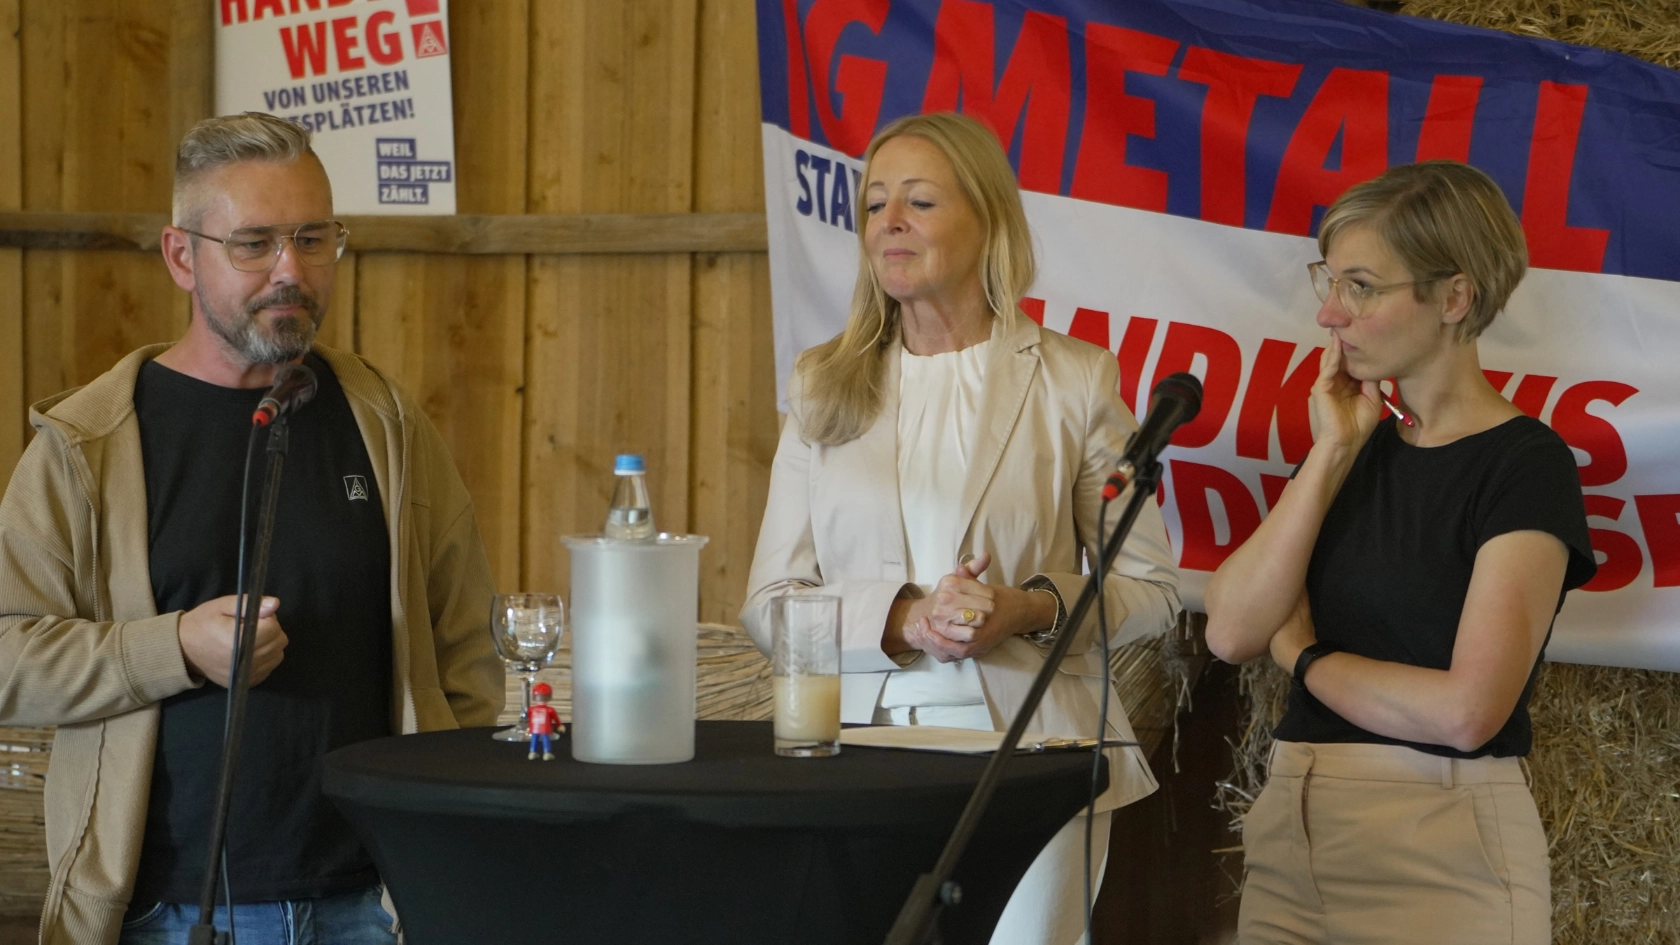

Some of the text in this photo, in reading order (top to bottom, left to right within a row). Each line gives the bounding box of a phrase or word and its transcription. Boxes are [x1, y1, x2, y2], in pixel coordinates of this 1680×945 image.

[279, 10, 404, 80] WEG
[264, 70, 409, 111] VON UNSEREN
[780, 0, 890, 158] IG
[379, 143, 413, 157] WEIL
[380, 165, 448, 182] DAS JETZT
[381, 185, 426, 202] ZÄHLT.
